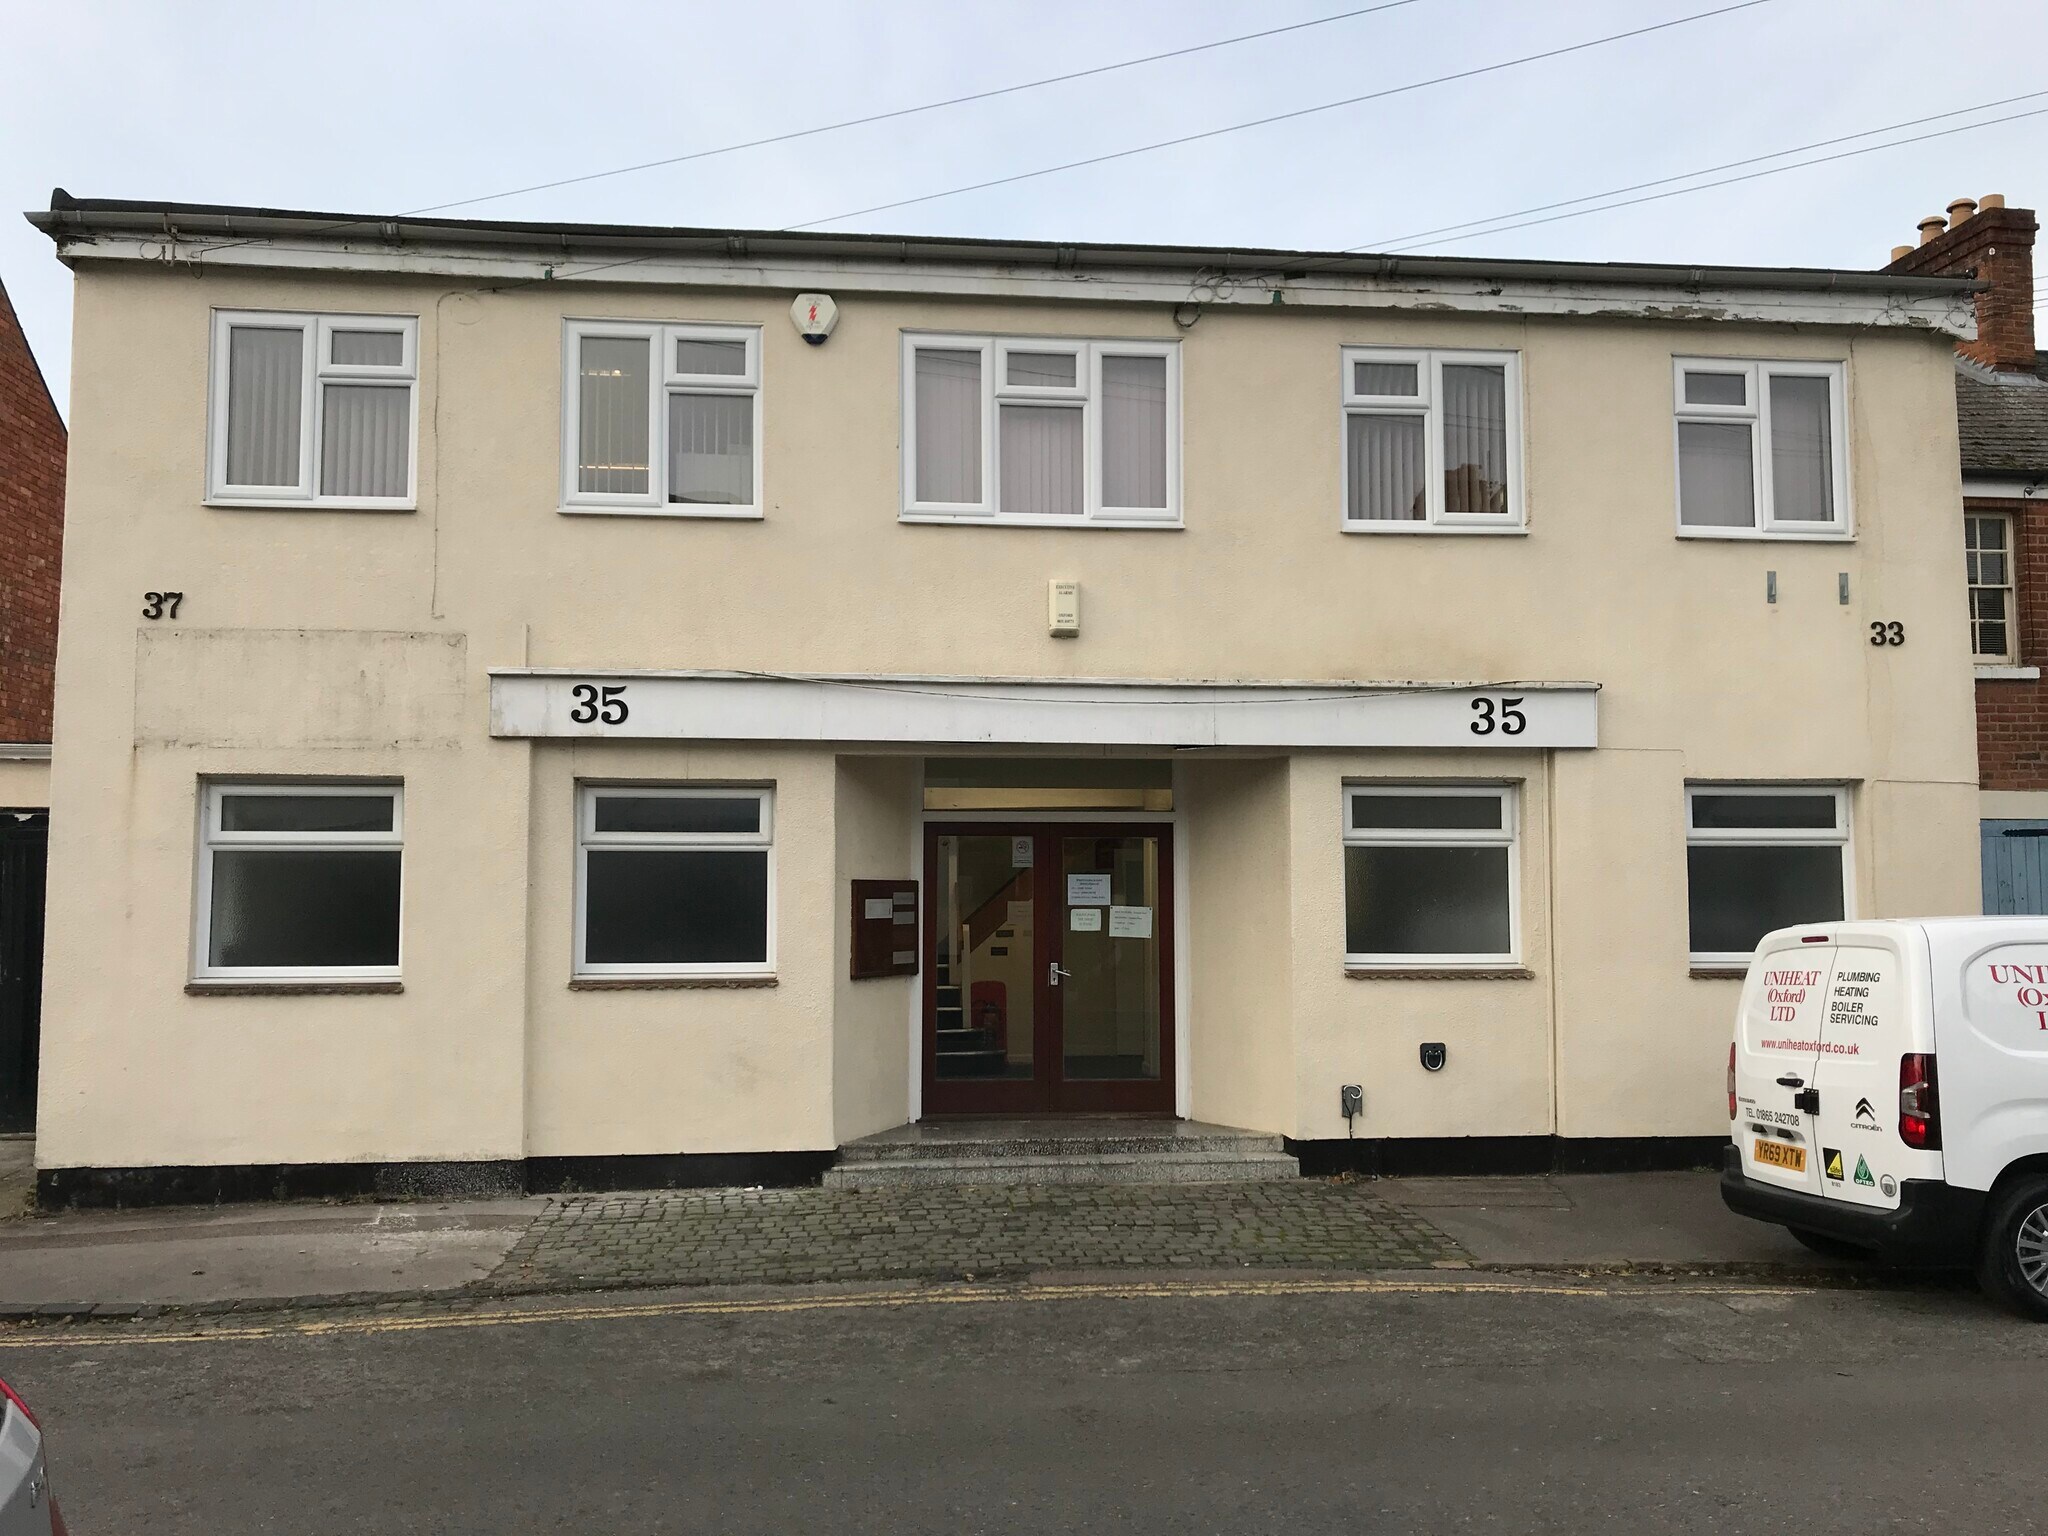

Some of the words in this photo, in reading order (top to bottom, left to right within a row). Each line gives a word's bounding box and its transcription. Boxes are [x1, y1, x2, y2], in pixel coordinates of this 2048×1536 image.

[142, 592, 183, 620] 37
[1870, 621, 1905, 646] 33
[571, 684, 629, 725] 35
[1470, 697, 1527, 735] 35
[1763, 971, 1821, 986] UNIHEAT
[1837, 972, 1881, 982] PLUMBING
[1767, 988, 1806, 1004] (Oxford)
[1834, 986, 1869, 997] HEATING
[1770, 1006, 1796, 1022] LTD
[1831, 1002, 1863, 1013] BOILER
[1830, 1013, 1878, 1026] SERVICING
[1761, 1039, 1859, 1055] www.uniheatoxford.co.uk
[1756, 1108, 1773, 1122] 01865
[1774, 1111, 1800, 1127] 242708
[1758, 1141, 1781, 1163] YR69
[1782, 1147, 1802, 1168] XTW
